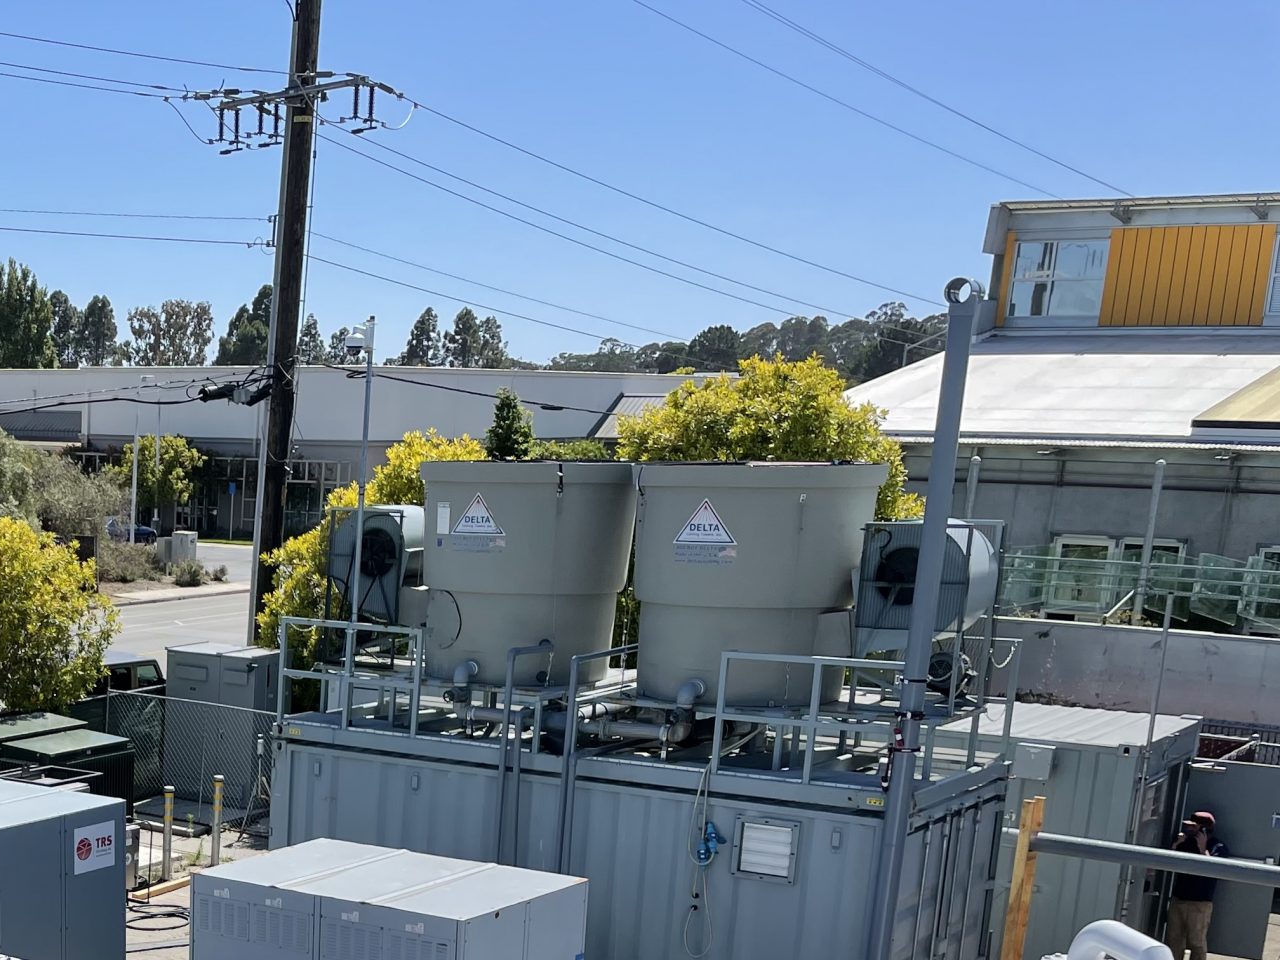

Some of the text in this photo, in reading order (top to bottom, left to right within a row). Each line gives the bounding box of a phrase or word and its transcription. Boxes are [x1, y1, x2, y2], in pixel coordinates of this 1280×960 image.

[464, 515, 491, 524] DELTA
[689, 523, 720, 532] DELTA
[95, 835, 113, 849] TRS
